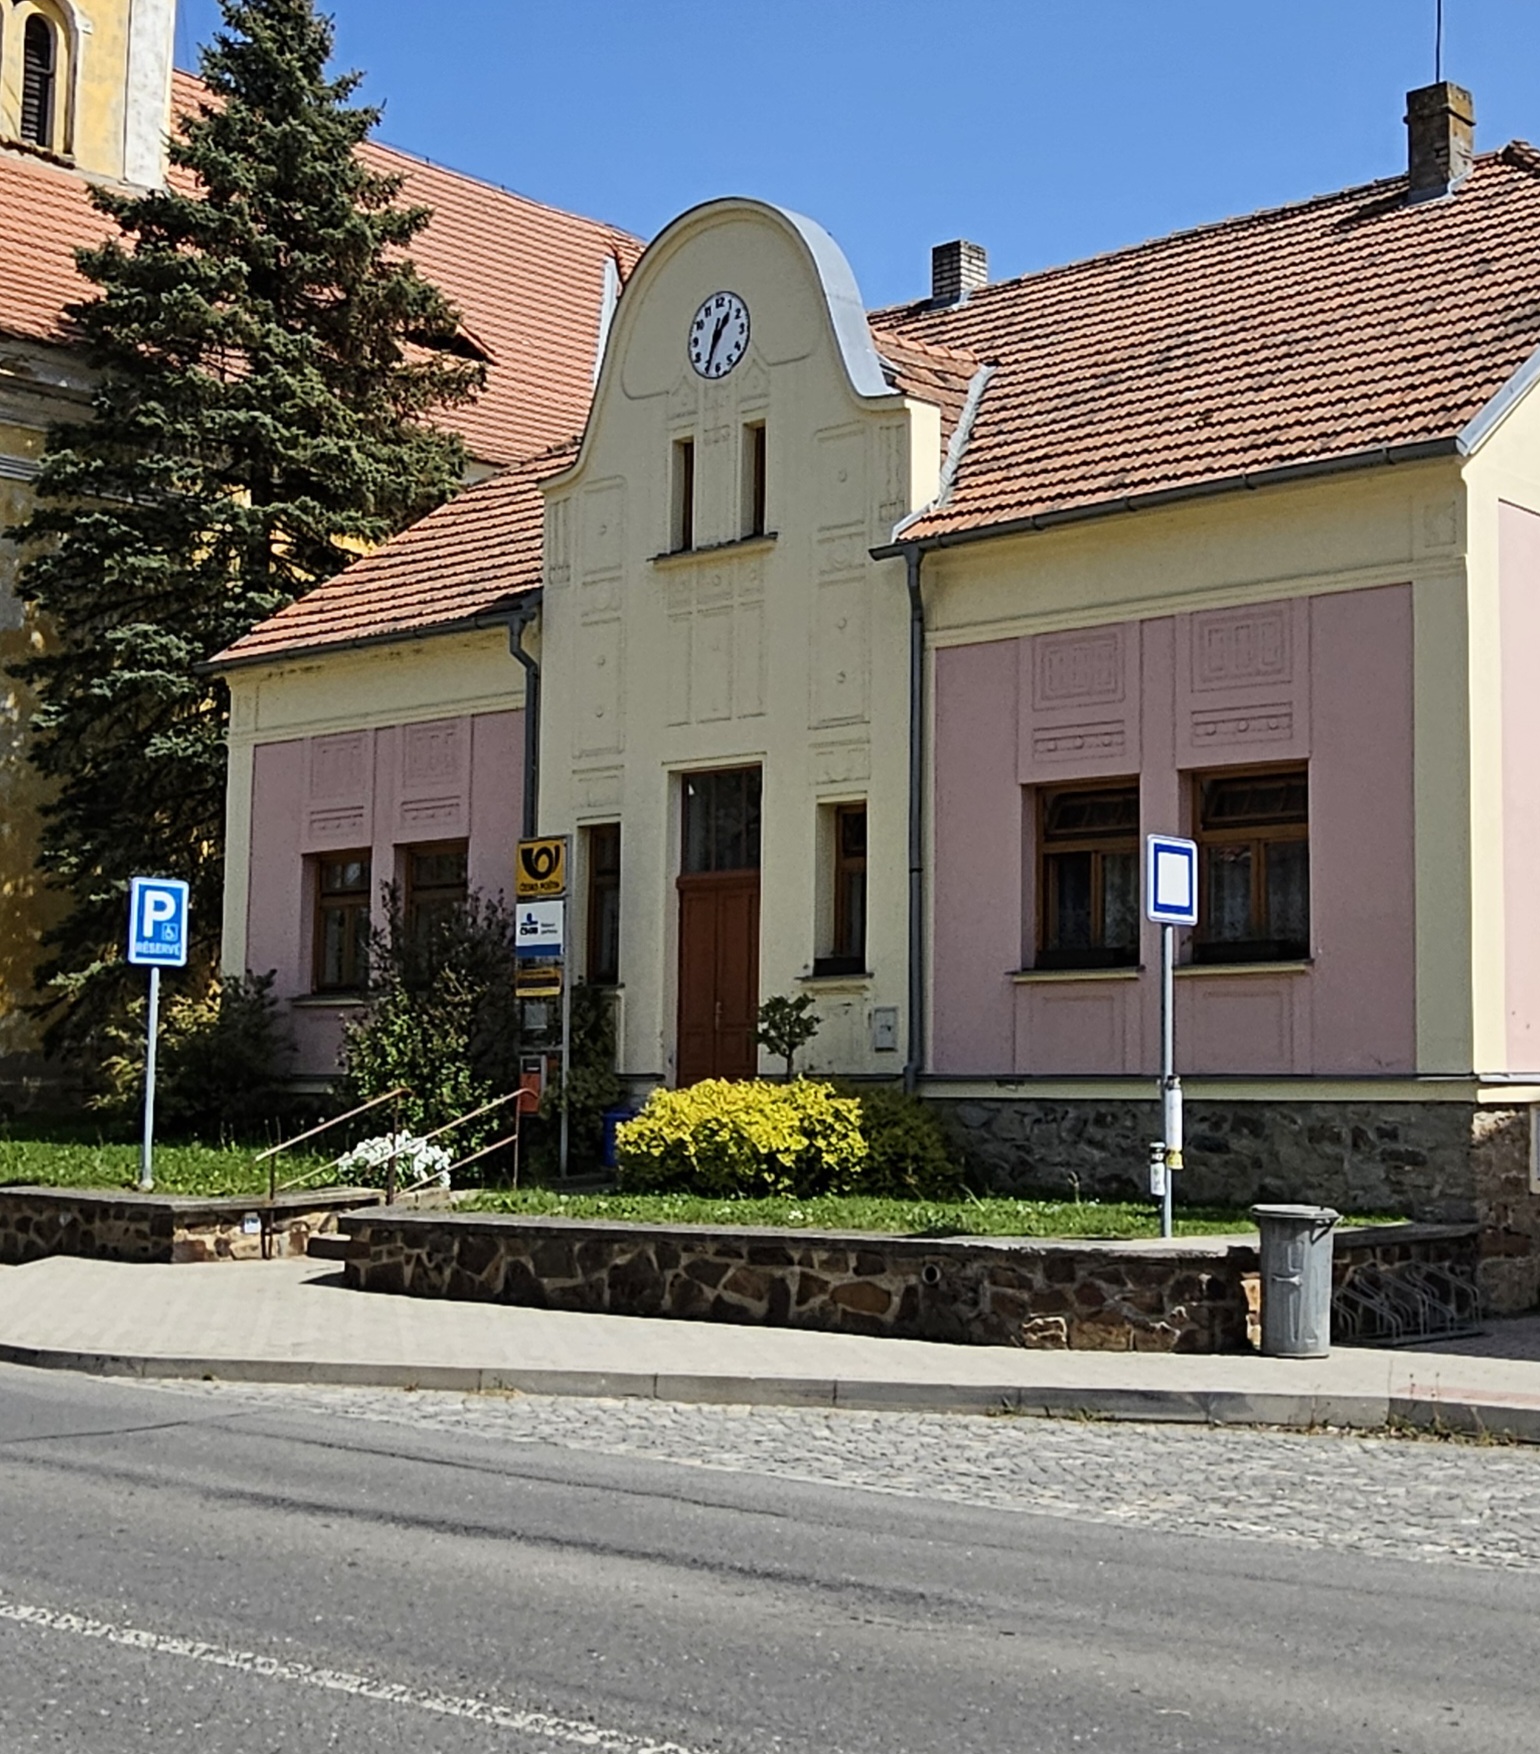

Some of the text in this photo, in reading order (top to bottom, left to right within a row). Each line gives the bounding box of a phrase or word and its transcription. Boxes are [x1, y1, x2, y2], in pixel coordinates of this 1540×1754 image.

[715, 296, 725, 309] 12
[704, 306, 712, 318] 11
[735, 308, 742, 320] 2
[696, 319, 705, 331] 10
[739, 322, 745, 335] 3
[692, 336, 699, 348] 9
[734, 341, 741, 352] 4
[693, 352, 702, 364] 8
[726, 353, 734, 366] 5
[715, 362, 722, 373] 6
[143, 890, 176, 938] P
